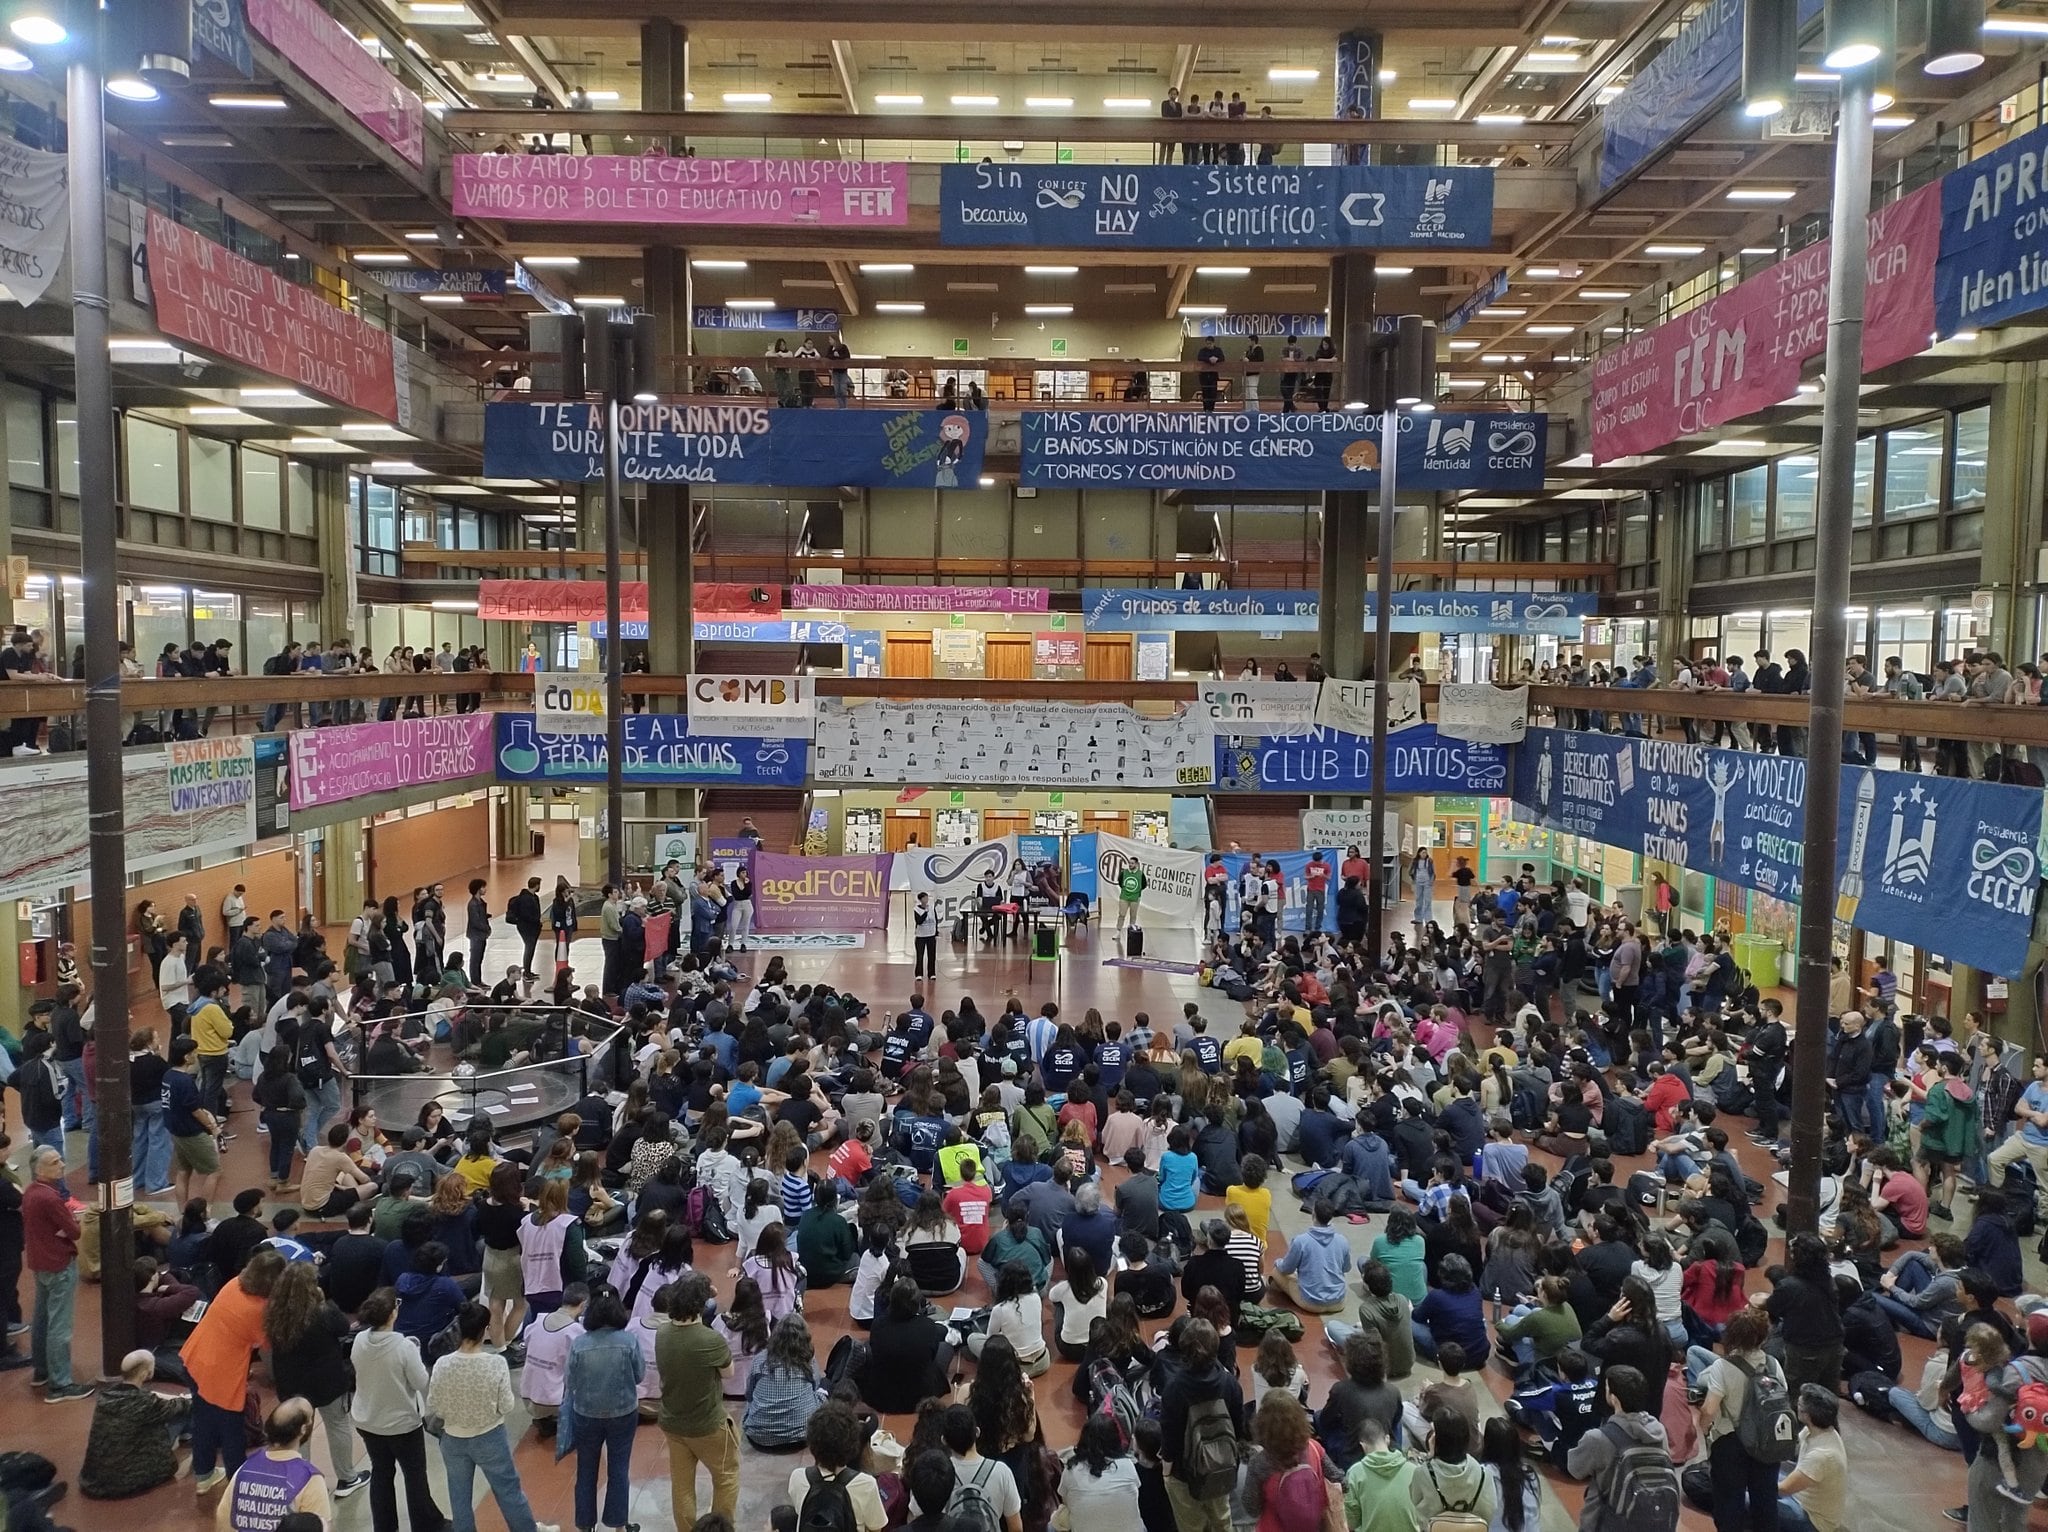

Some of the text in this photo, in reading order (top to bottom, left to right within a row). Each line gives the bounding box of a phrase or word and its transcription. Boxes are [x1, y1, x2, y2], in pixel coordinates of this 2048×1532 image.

[461, 156, 892, 184] LOGRAMOS +BECAS DE TRANSPORTE
[975, 163, 1023, 190] Sin
[1037, 180, 1088, 191] CONICET
[1101, 174, 1140, 202] NO
[1206, 170, 1301, 196] Sistema
[463, 183, 782, 210] VAMOS POR BOLETO EDUCATIVO
[961, 200, 1029, 224] becarixs
[1096, 209, 1140, 233] HAY
[1202, 206, 1316, 235] científico
[1416, 223, 1445, 232] CECEN
[153, 214, 353, 340] POR UN CECEN QUE ENFRENTE
[164, 256, 191, 300] EL
[202, 277, 257, 328] AJUSTE
[261, 304, 281, 338] DE
[321, 333, 329, 358] Y
[334, 337, 348, 367] EL
[354, 347, 377, 380] FMI
[697, 308, 767, 329] PRE-PARCIAL
[1215, 314, 1319, 336] RECORRIDAS POR
[1689, 300, 1719, 340] CBC
[185, 303, 215, 347] EN
[276, 342, 288, 374] Y
[1621, 350, 1631, 366] DE
[1674, 318, 1748, 409] FEM
[1621, 382, 1631, 398] DE
[531, 402, 771, 435] TE AOMPAÑAMOS
[1088, 412, 1251, 434] ACOMPAÑAMIENTO
[1490, 420, 1536, 431] Presidencia
[1678, 398, 1714, 434] CBC
[676, 432, 745, 459] TODA
[1045, 436, 1315, 457] BAÑOS SIN DISTINCIÓN DE GÉNERO
[585, 456, 717, 482] la Cursada
[1044, 462, 1237, 481] TORNEOS Y COMUNIDAD
[1424, 458, 1470, 470] Identidad
[1488, 456, 1533, 470] CECEN
[484, 596, 608, 617] DEFENDAMOS
[793, 588, 953, 612] SALARIOS DIGNOS PARA DEFENDER
[1010, 589, 1041, 608] FEM
[1121, 596, 1286, 621] grupos de estudio y
[1412, 598, 1480, 618] los labos
[1531, 593, 1574, 603] Presidencia
[700, 622, 760, 641] aprobar
[544, 685, 605, 715] CODA
[875, 702, 924, 711] Estudiantes
[926, 702, 989, 712] desaparecidos
[1003, 704, 1011, 712] la
[1012, 704, 1047, 714] facultad
[1049, 705, 1060, 714] de
[1061, 705, 1097, 715] ciencias
[329, 729, 359, 746] BECAS
[393, 719, 471, 748] LO PEDIMOS
[650, 718, 666, 741] A
[172, 738, 243, 765] EXIGIMOS
[542, 742, 737, 771] FERIA DE CIENCIAS
[1640, 740, 1705, 780] REFORMAS
[170, 765, 194, 786] MAS
[395, 745, 477, 784] LO LOGRAMOS
[756, 765, 783, 776] CECEN
[819, 765, 854, 778] agdFCEN
[1177, 766, 1212, 784] CECEN
[1262, 746, 1466, 783] CLUB DATOS
[1563, 751, 1609, 780] DERECHOS
[945, 772, 971, 781] Juicio
[972, 774, 978, 782] y
[979, 773, 1010, 784] castigo
[1019, 775, 1031, 783] los
[1033, 775, 1090, 785] responsables
[1467, 777, 1504, 789] CECEN
[1563, 774, 1616, 807] ESTUDIANTILES
[1651, 775, 1662, 793] en
[1748, 758, 1808, 809] MODELO
[170, 778, 253, 813] UNIVERSITARIO
[1647, 797, 1689, 834] PLANES
[1321, 838, 1333, 847] EN
[1976, 819, 2029, 846] Presidencia
[1643, 832, 1689, 868] ESTUDIO
[1155, 865, 1197, 887] CONICET
[1740, 860, 1752, 878] de
[761, 869, 882, 905] agdFCEN
[1176, 883, 1194, 899] UBA
[1881, 884, 1923, 904] Identidad
[1967, 870, 2035, 917] CECEN
